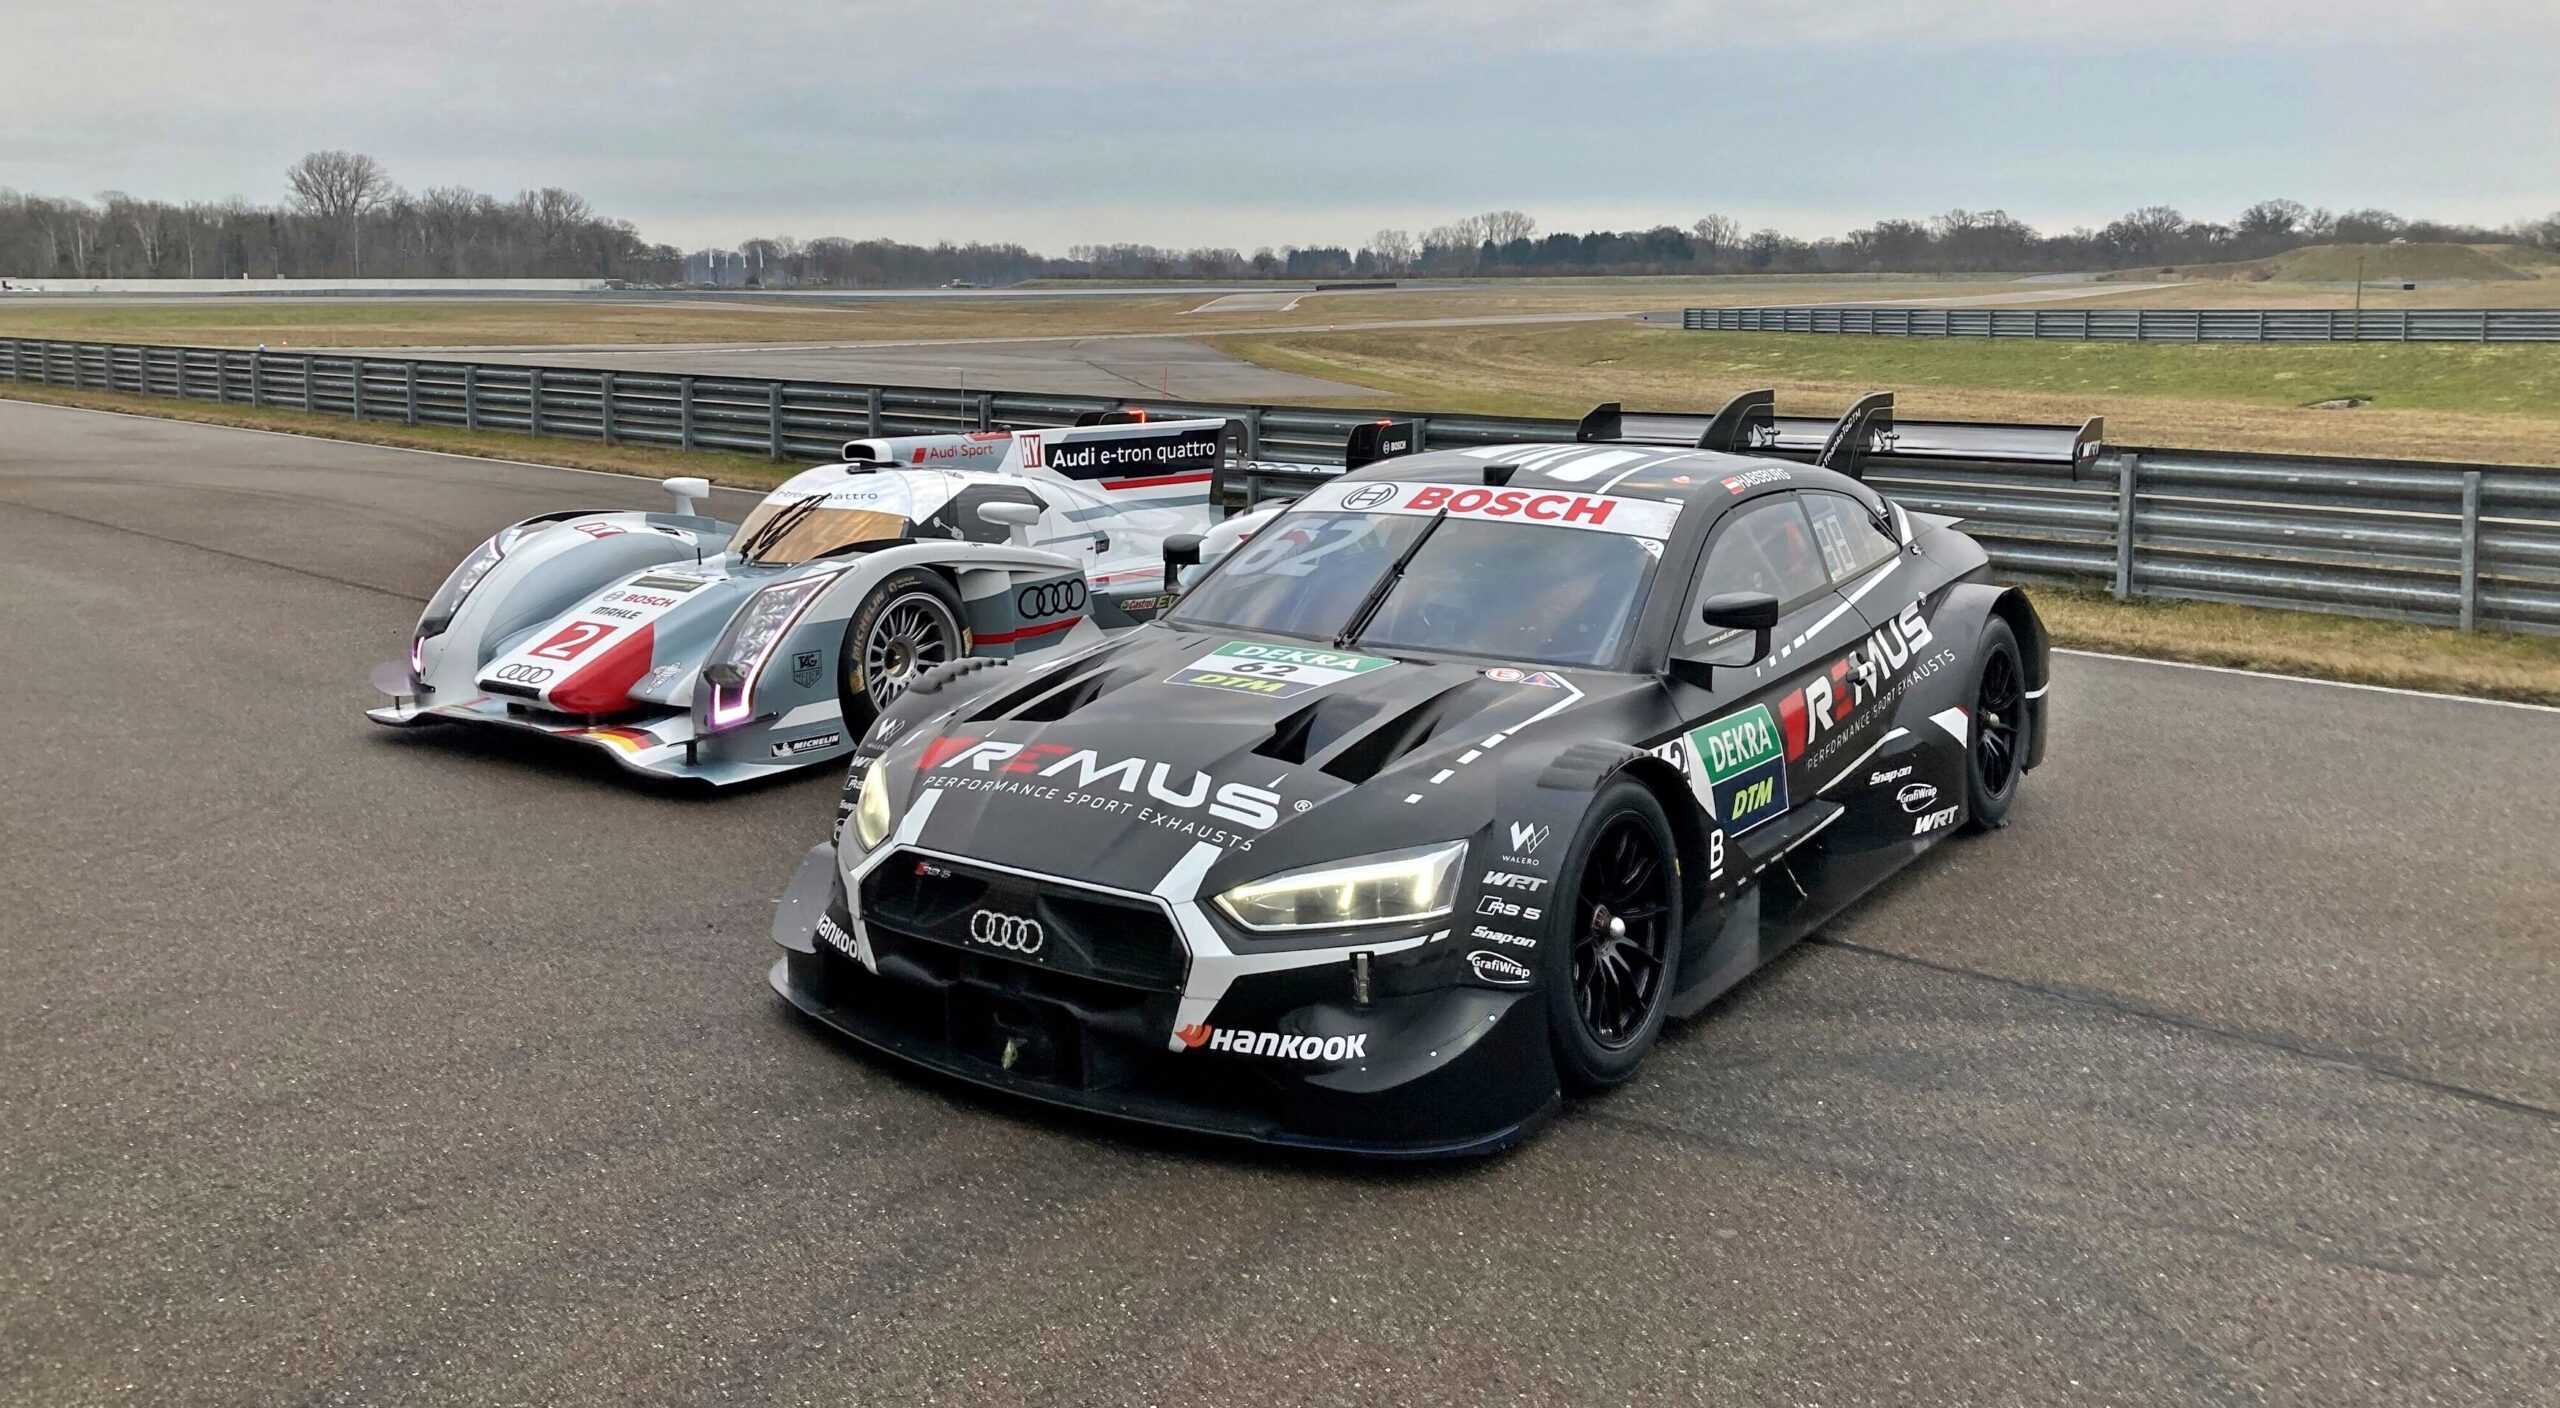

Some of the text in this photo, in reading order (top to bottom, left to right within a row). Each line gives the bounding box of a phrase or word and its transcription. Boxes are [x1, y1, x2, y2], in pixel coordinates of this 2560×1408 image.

[1391, 440, 1406, 451] BOSCH
[1820, 408, 1862, 468] ThanksToDTM
[930, 444, 994, 459] Audi Sport
[1021, 436, 1040, 466] HY
[1052, 441, 1216, 467] Audi e-tron quattro
[1735, 468, 1792, 488] HABSBURG
[819, 491, 879, 500] uattro
[1404, 486, 1618, 525] BOSCH
[1225, 518, 1377, 577] 62
[622, 594, 677, 607] BOSCH
[1128, 599, 1154, 609] Castrol
[591, 606, 643, 620] MAHLE
[852, 591, 885, 661] MICHELIN
[538, 624, 601, 657] 2
[798, 654, 818, 668] TAG
[1232, 661, 1299, 677] 62
[1233, 646, 1360, 670] DEKRA
[1190, 673, 1287, 692] DTM
[1807, 649, 1956, 771] PERFORMANCE SPORT EXHAUSTS
[793, 734, 839, 750] MICHELIN
[1708, 717, 1773, 773] DEKRA
[940, 741, 1282, 830] REMUS
[1869, 766, 1912, 785] Snap-on
[1731, 776, 1774, 820] DTM
[1900, 786, 1938, 803] GrafiWrap
[923, 776, 1255, 851] PERFORMANCE SPORT EXHAUSTS
[1912, 805, 1959, 836] WRT
[1502, 854, 1540, 866] WALERO
[1710, 828, 1725, 870] B
[1482, 870, 1548, 892] WRT
[1487, 901, 1542, 920] RS 5
[1470, 925, 1537, 948] Snap-on
[1471, 956, 1531, 979] GrafiWrap
